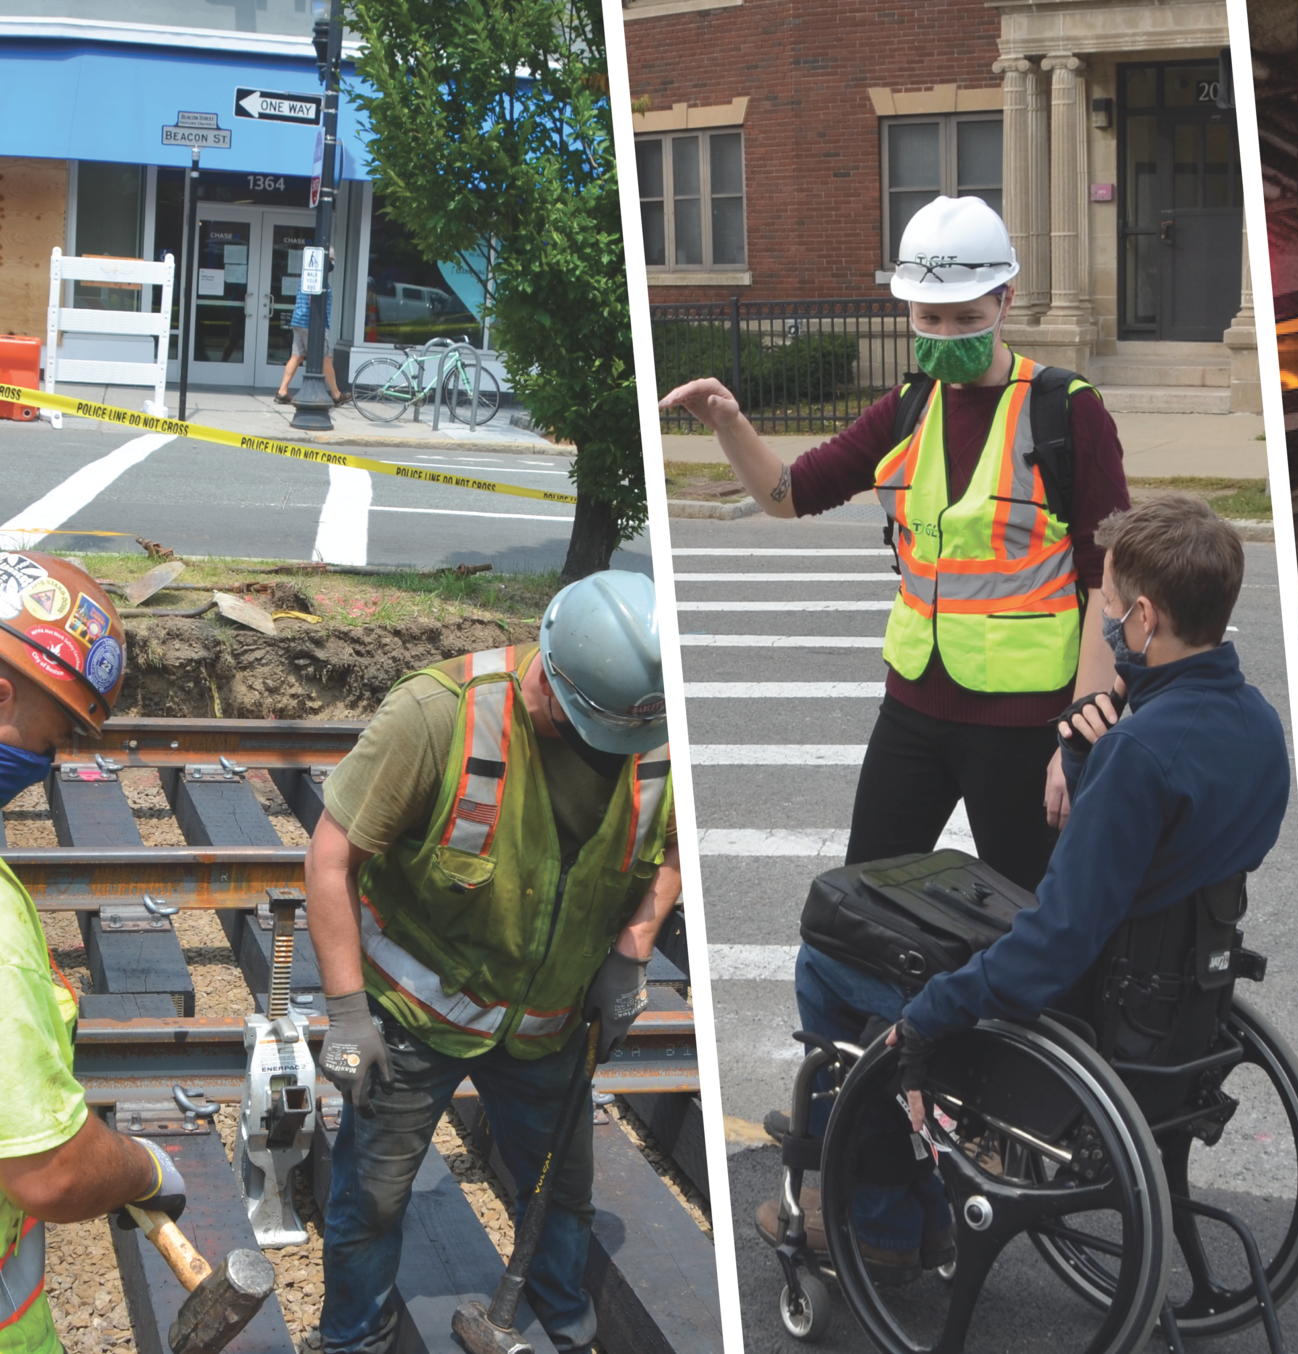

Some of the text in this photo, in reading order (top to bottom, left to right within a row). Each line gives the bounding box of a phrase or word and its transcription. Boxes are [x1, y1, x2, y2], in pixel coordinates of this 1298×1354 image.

[260, 99, 312, 116] ONE WAY
[180, 114, 198, 122] BEACON
[165, 130, 228, 144] BEACON ST.
[247, 175, 285, 191] 1364
[210, 232, 233, 240] CHASE
[283, 237, 306, 245] CHASE
[76, 402, 190, 436] POLICE LINE DO NOT CROSS
[240, 436, 348, 466] POLICE LINE DO NOT CROSS
[396, 466, 422, 480] POLICE
[424, 472, 441, 483] LINE
[454, 478, 471, 488] NOT
[471, 480, 497, 492] CROSS
[32, 651, 42, 664] City
[46, 664, 64, 676] Boston
[102, 660, 112, 672] 22
[262, 1064, 300, 1072] ENERPAC
[325, 1063, 357, 1074] MaxiFlex
[535, 1152, 552, 1194] VULCAN
